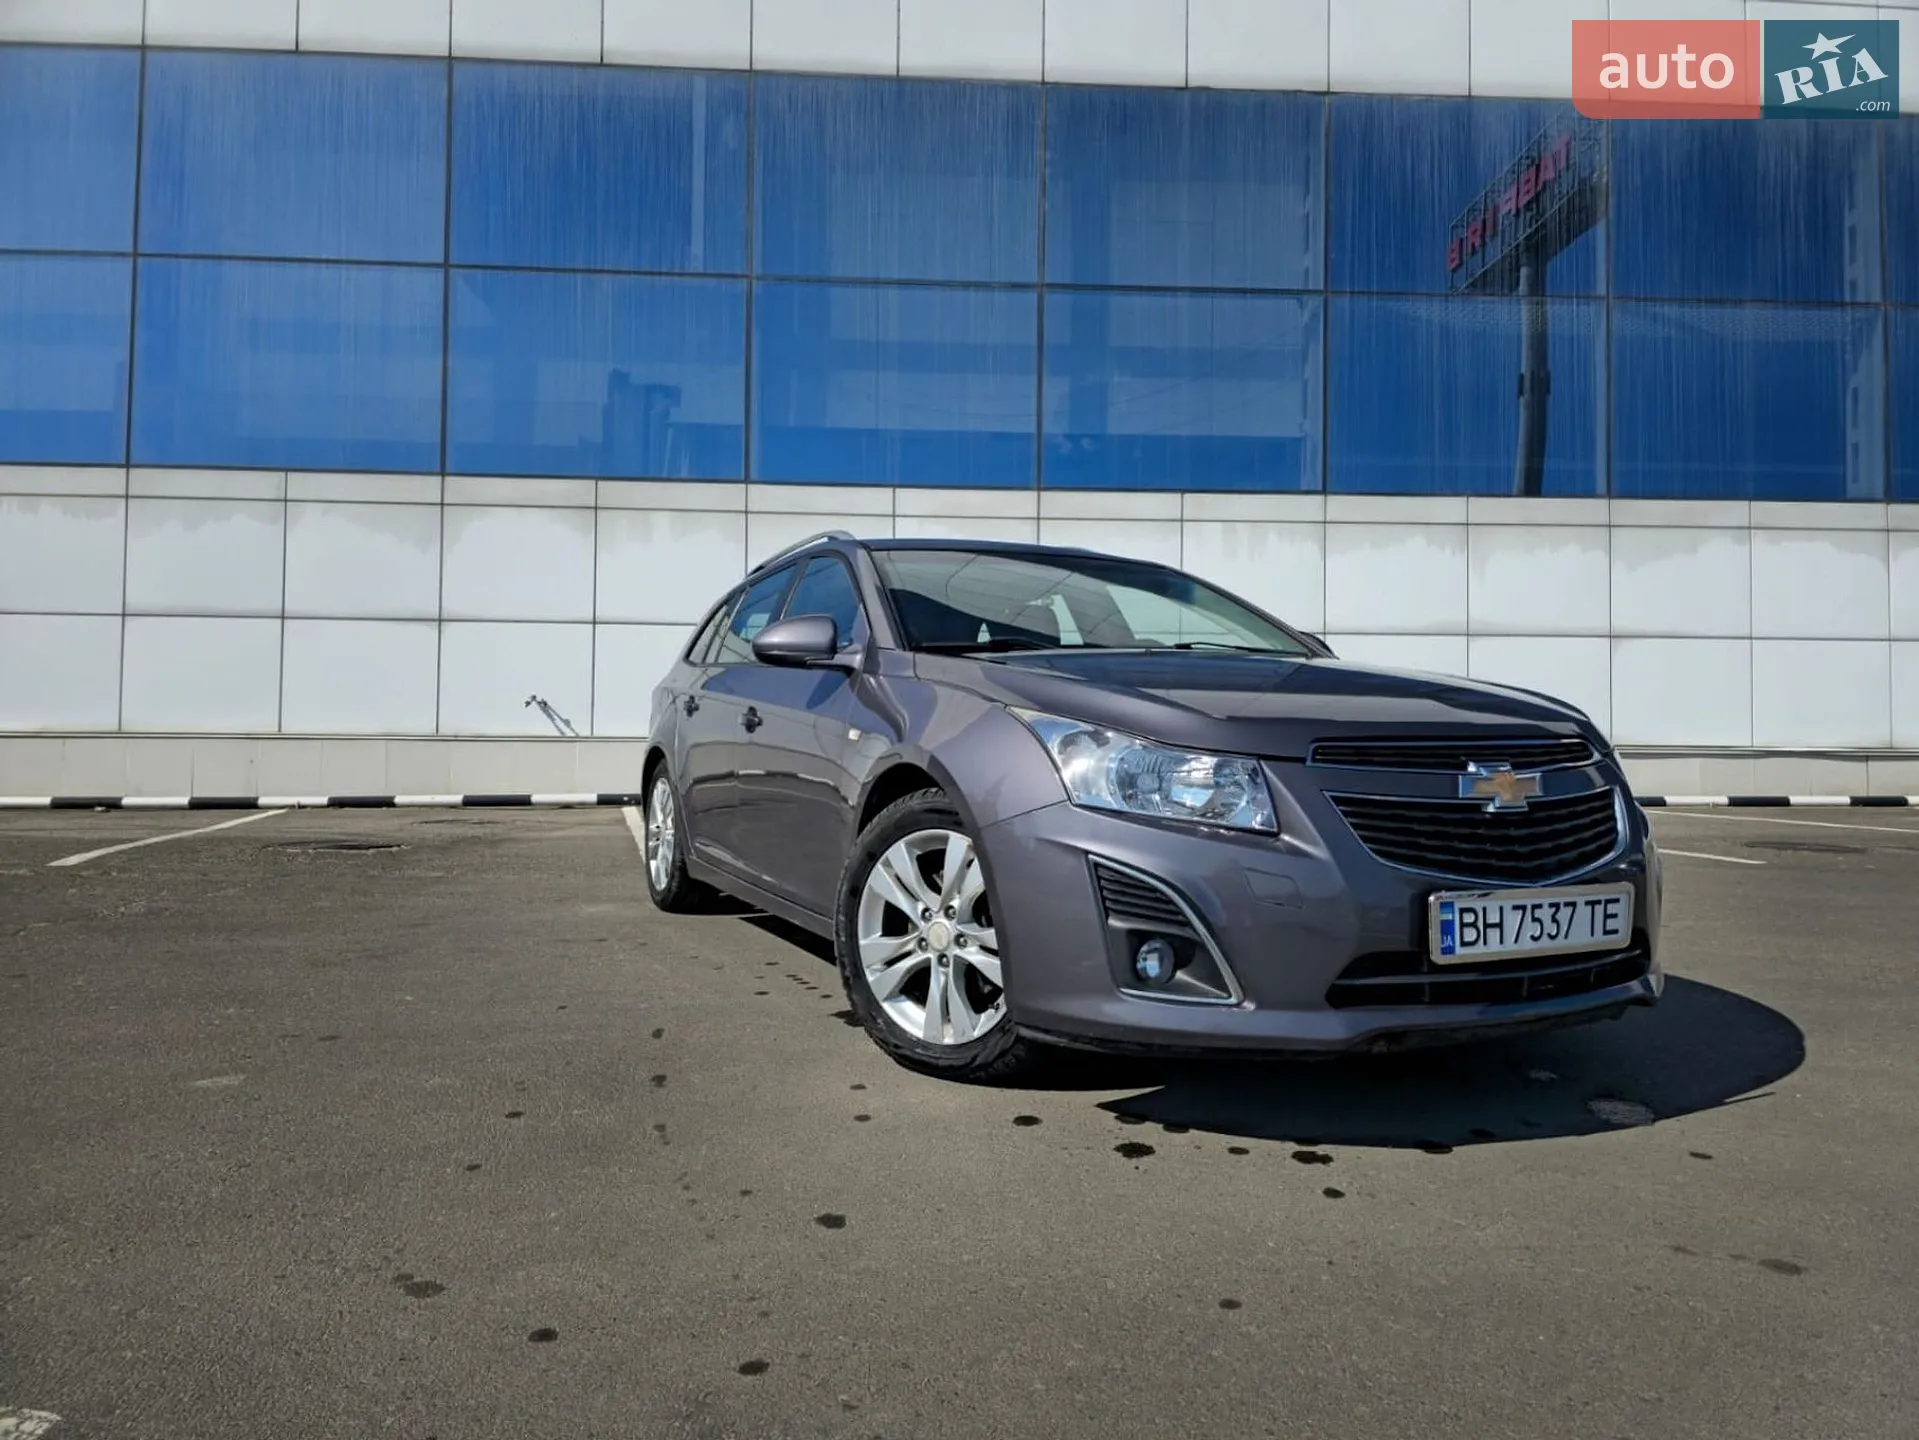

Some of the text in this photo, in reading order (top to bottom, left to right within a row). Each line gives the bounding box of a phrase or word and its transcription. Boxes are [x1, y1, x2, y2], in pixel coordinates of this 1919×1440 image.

[1459, 898, 1621, 947] BH 7537 TE
